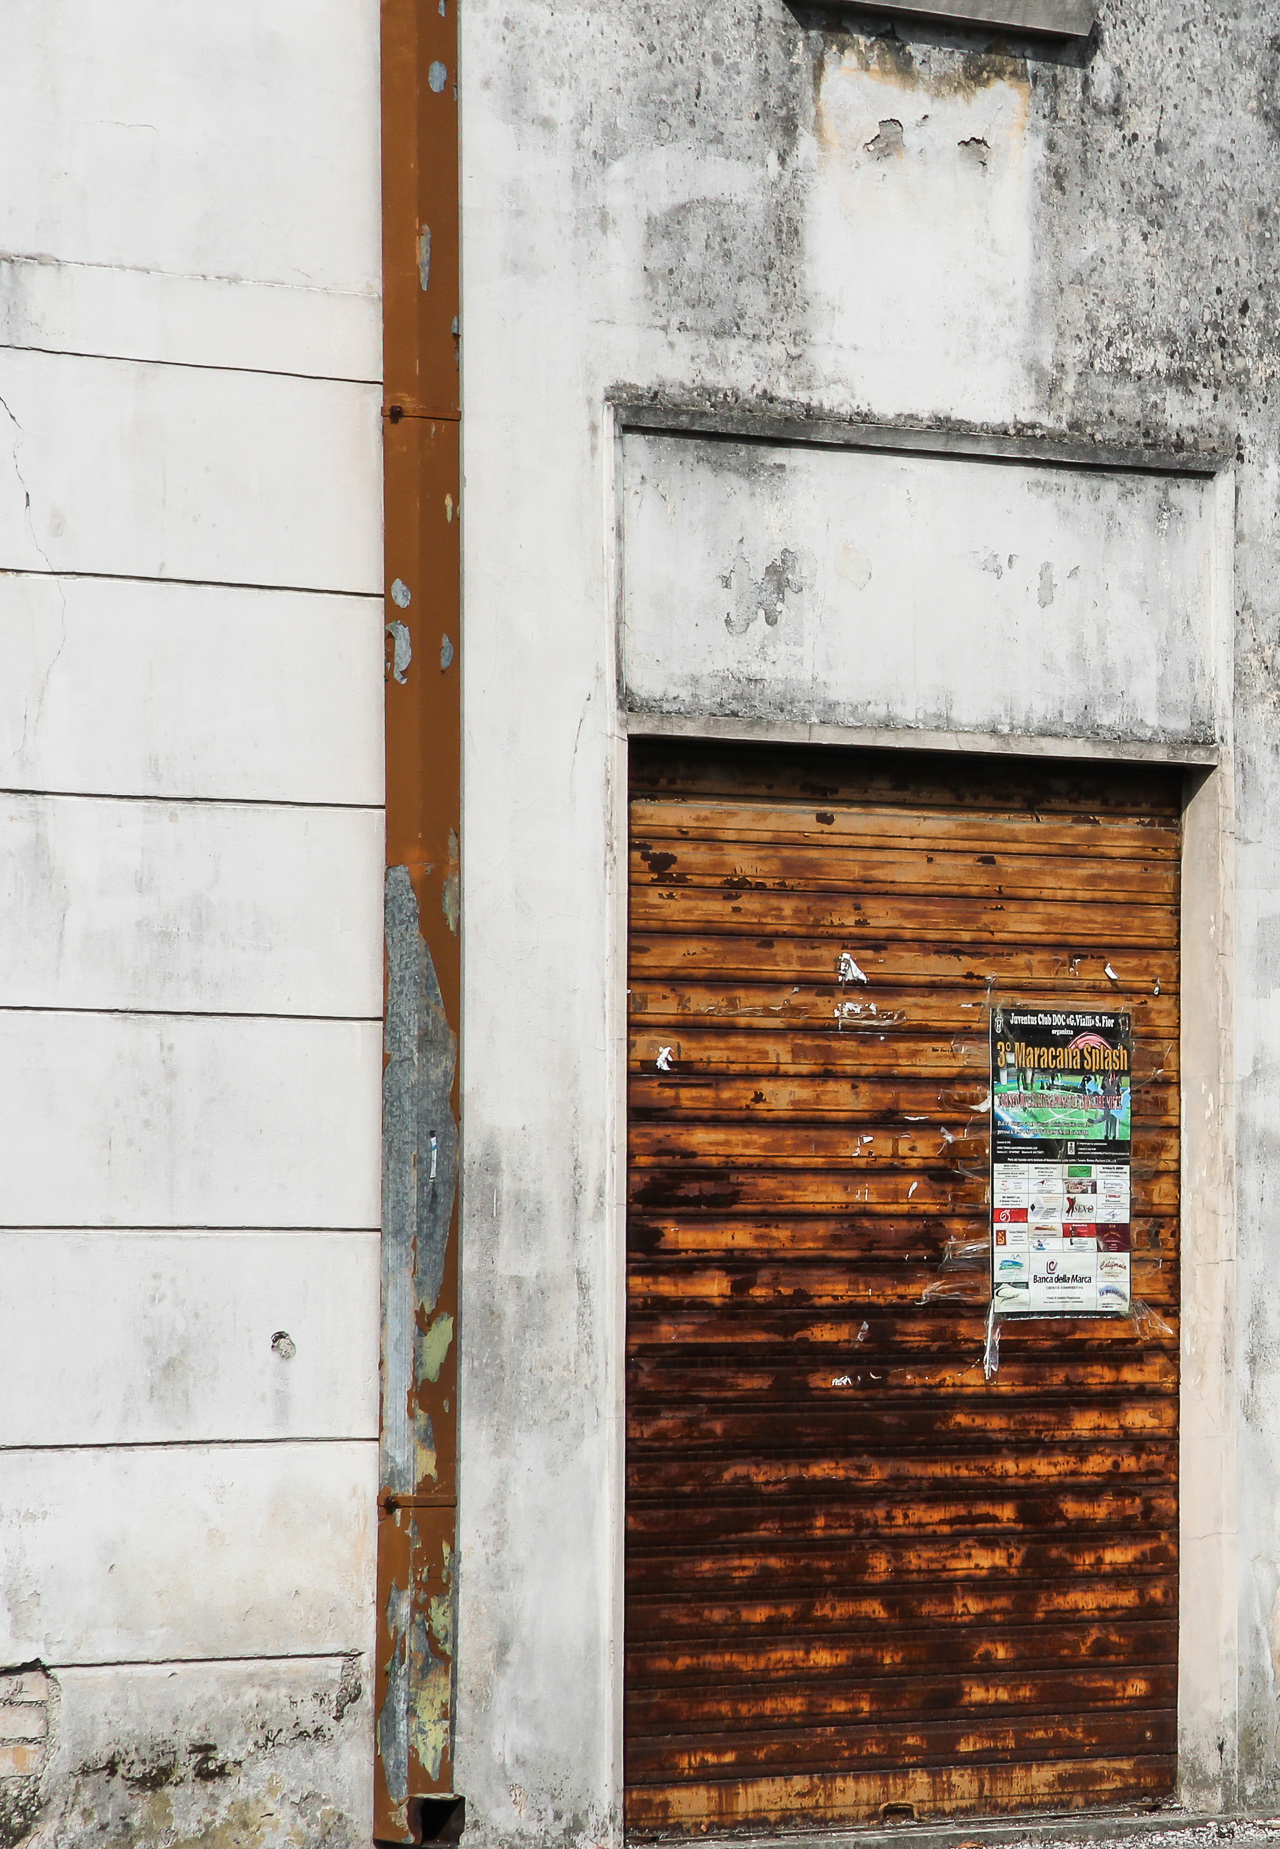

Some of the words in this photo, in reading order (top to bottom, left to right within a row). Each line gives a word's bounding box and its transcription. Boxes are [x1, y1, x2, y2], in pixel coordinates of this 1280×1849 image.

[1010, 1013, 1037, 1025] Juventus
[1038, 1013, 1051, 1026] Club
[1052, 1014, 1065, 1026] DOC
[1095, 1015, 1101, 1027] S.
[1102, 1016, 1114, 1028] Fior
[1084, 1043, 1128, 1072] Splash
[1033, 1274, 1053, 1283] Banca
[1054, 1274, 1070, 1283] della
[1071, 1274, 1092, 1284] Marca
